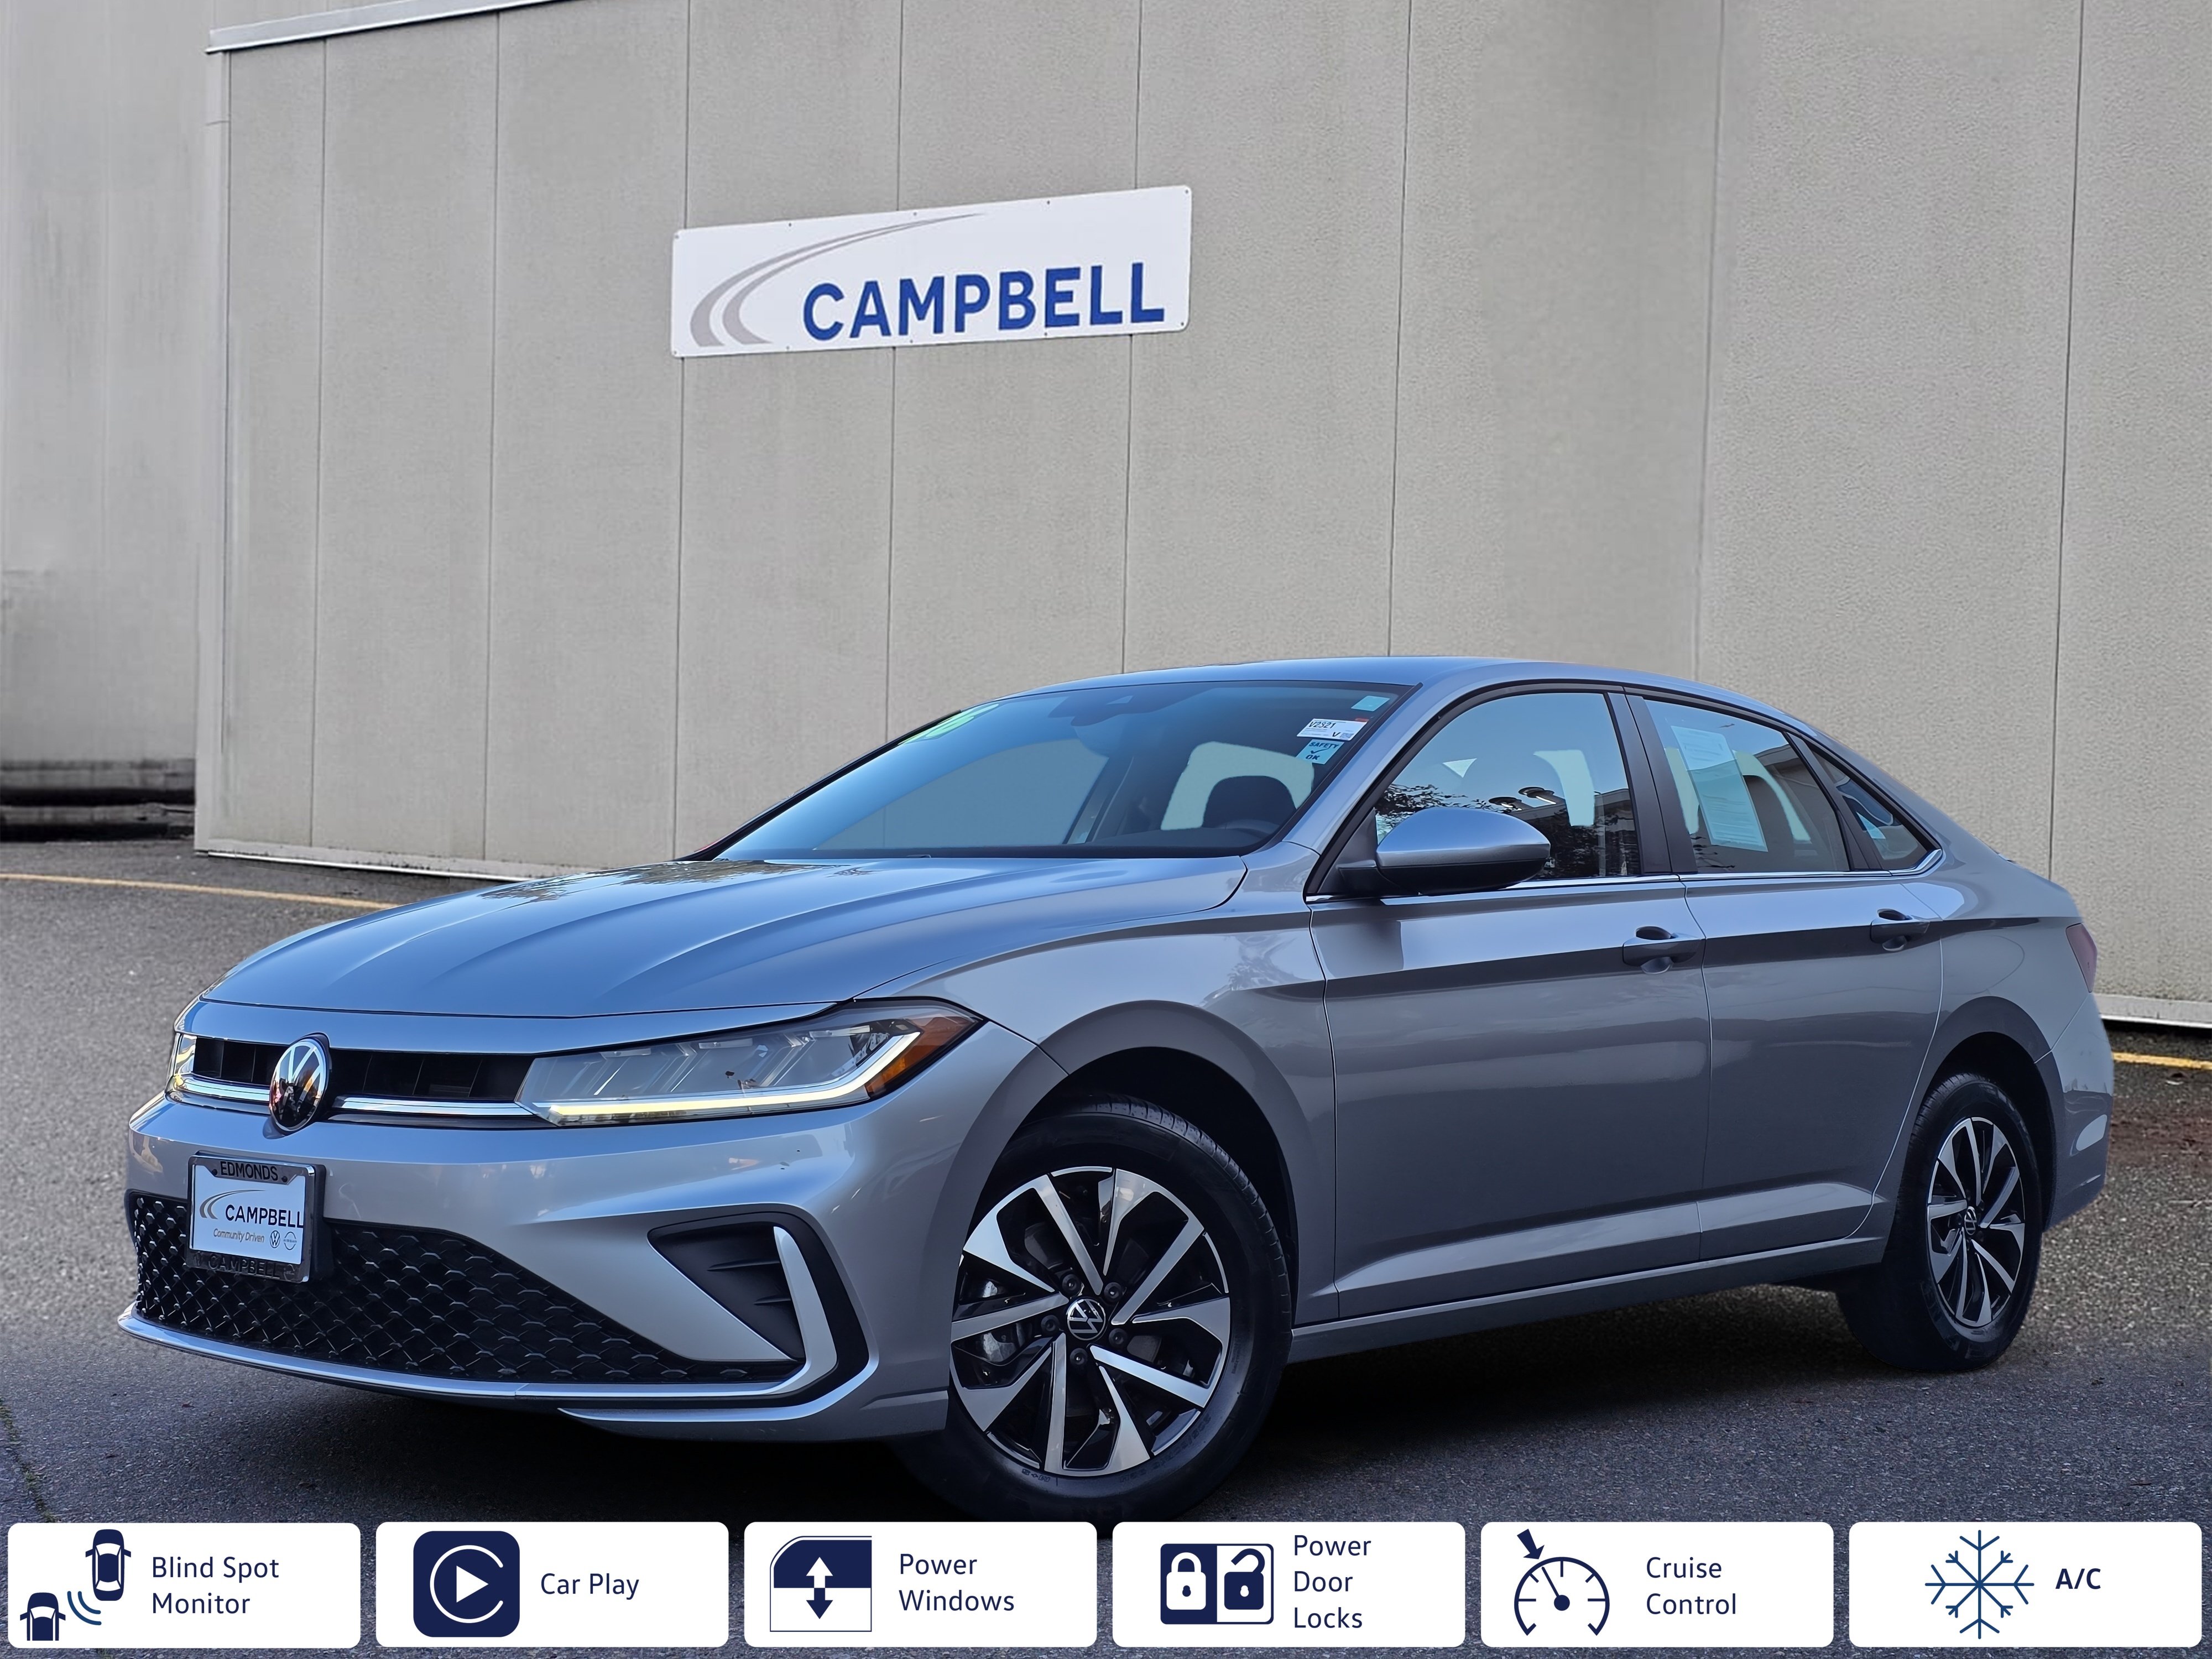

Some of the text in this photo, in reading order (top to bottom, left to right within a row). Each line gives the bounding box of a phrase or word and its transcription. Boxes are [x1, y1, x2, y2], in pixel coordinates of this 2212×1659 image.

[803, 262, 1165, 341] CAMPBELL
[220, 1161, 278, 1181] EDMONDS
[225, 1204, 304, 1228] CAMPBELL
[213, 1228, 265, 1243] Community Driven
[208, 1254, 280, 1279] CAMPBELL
